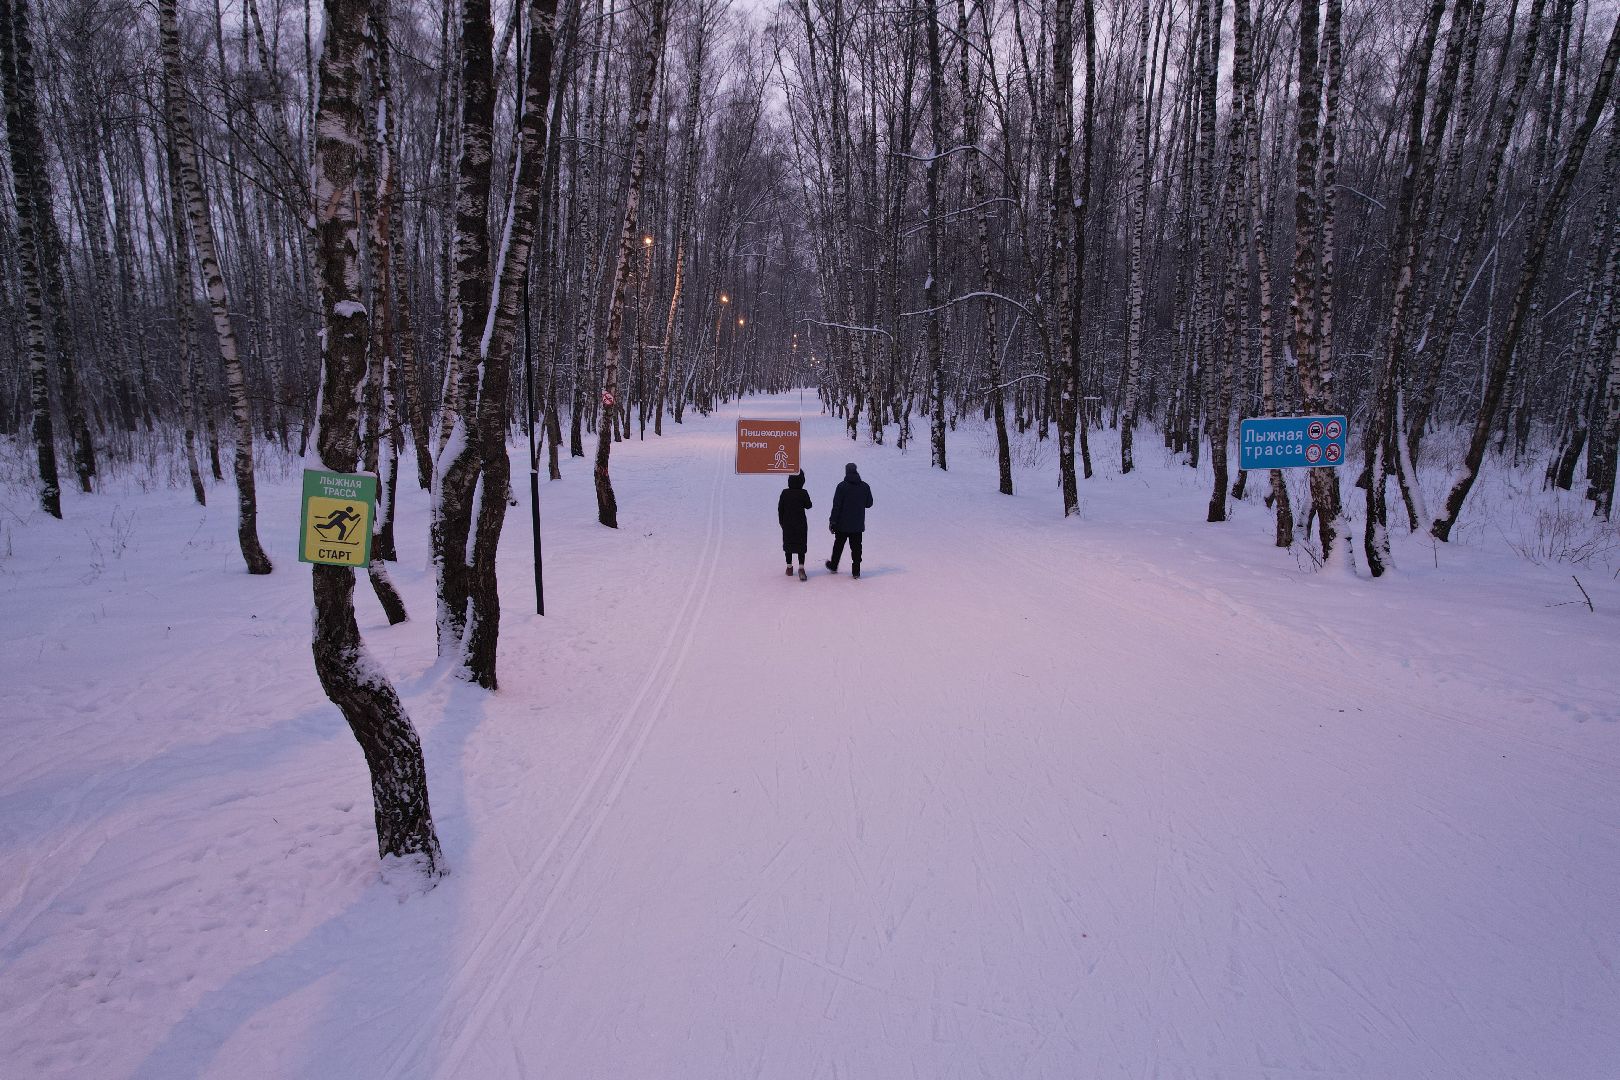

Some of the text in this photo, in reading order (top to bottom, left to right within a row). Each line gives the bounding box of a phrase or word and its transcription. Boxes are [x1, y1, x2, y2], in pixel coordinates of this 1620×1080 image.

[740, 428, 798, 438] Пешеходная
[1245, 429, 1303, 442] Лыжная
[740, 441, 768, 450] тропа
[1245, 444, 1303, 459] трасса
[320, 476, 362, 488] ЛЫЖНАЯ
[323, 486, 357, 498] ТРАССА
[318, 549, 352, 560] СТАРТ
